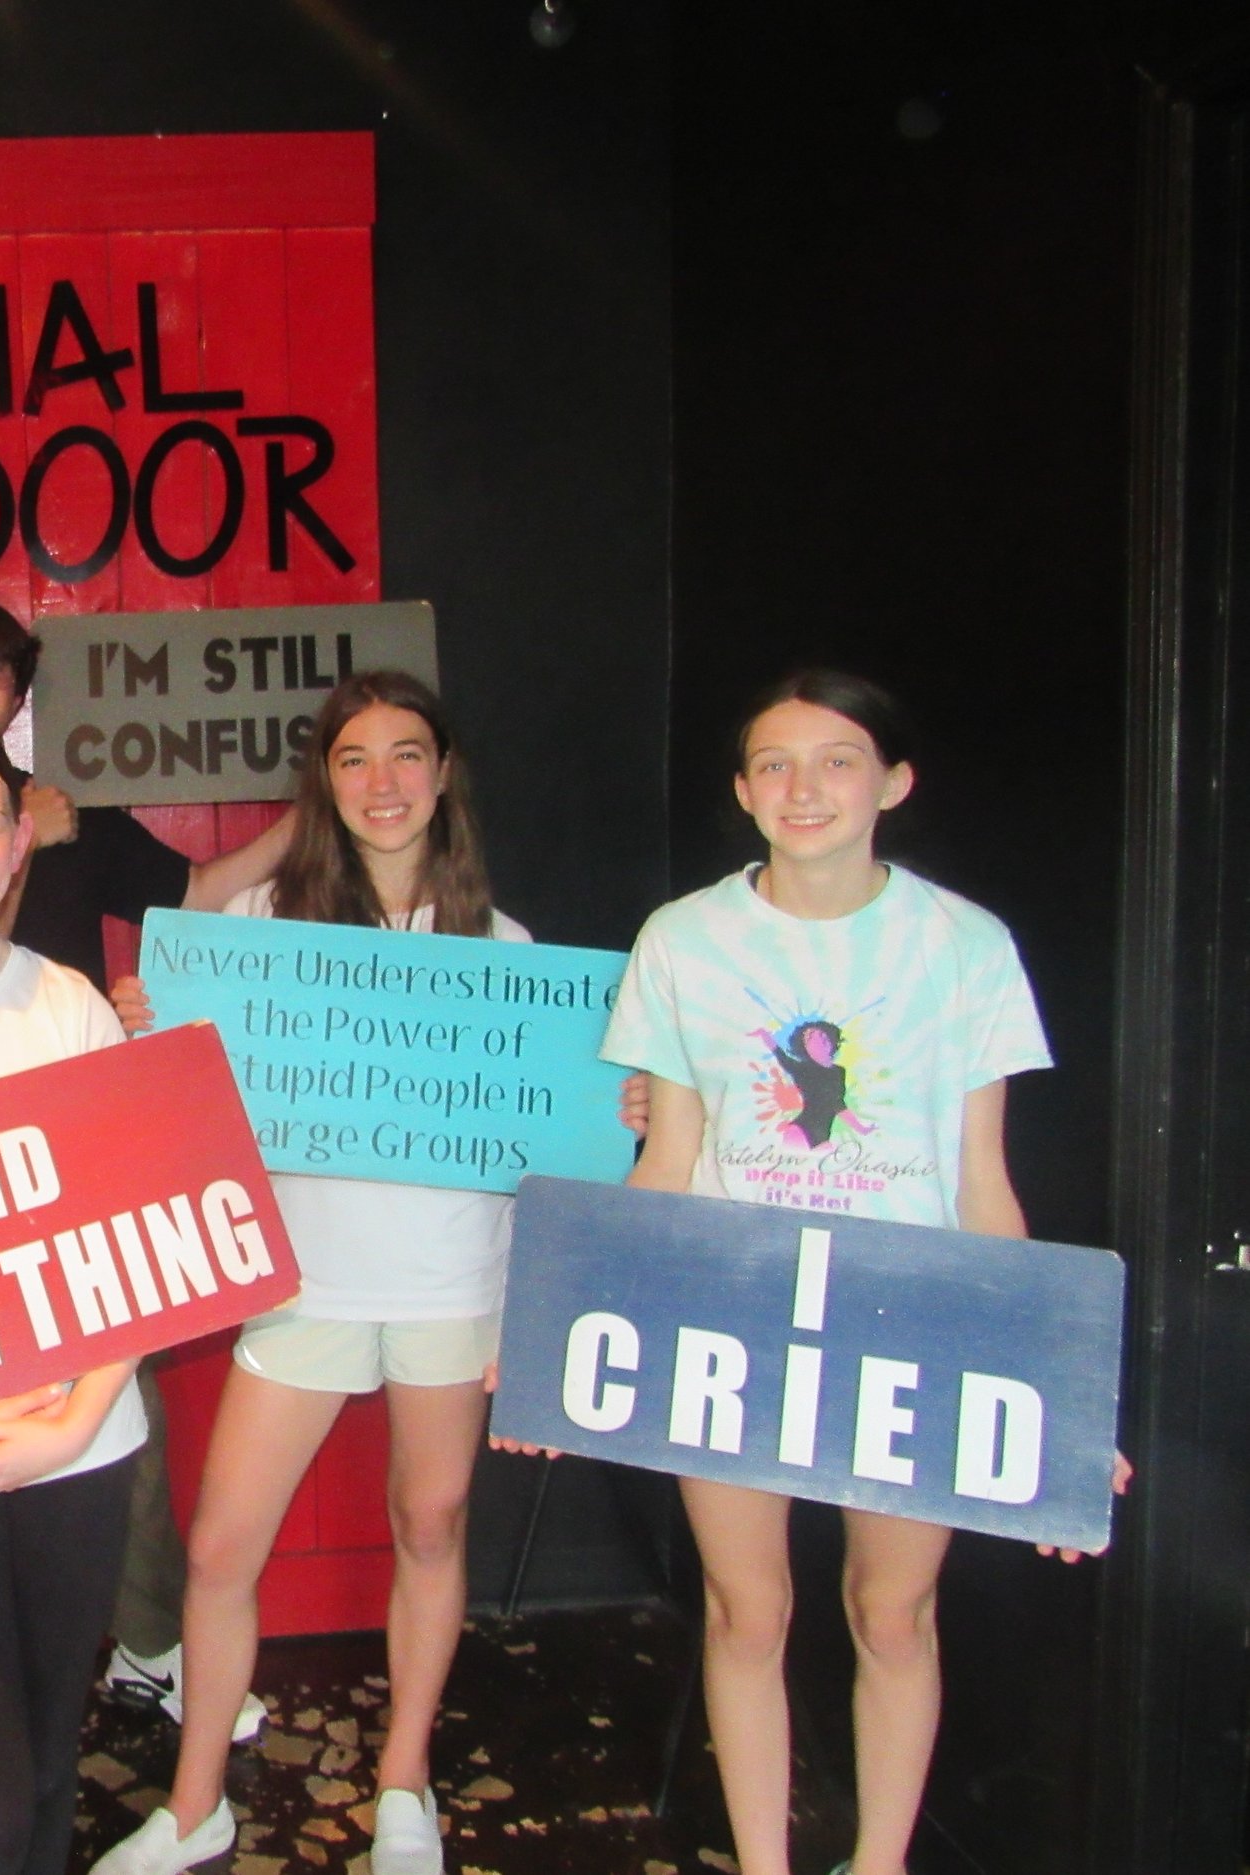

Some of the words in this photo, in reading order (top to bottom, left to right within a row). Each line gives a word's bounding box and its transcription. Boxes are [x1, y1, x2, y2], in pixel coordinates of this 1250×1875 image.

[87, 641, 169, 698] I'M
[64, 715, 316, 781] CONFUS
[150, 936, 284, 984] Never
[242, 998, 313, 1041] the
[324, 1006, 472, 1054] Power
[483, 1021, 533, 1058] of
[228, 1052, 356, 1105] tupid
[365, 1064, 507, 1118] People
[517, 1077, 553, 1117] in
[255, 1118, 360, 1163] arge
[371, 1121, 530, 1177] Groups
[792, 1227, 832, 1333] I
[562, 1311, 1044, 1505] CRIED
